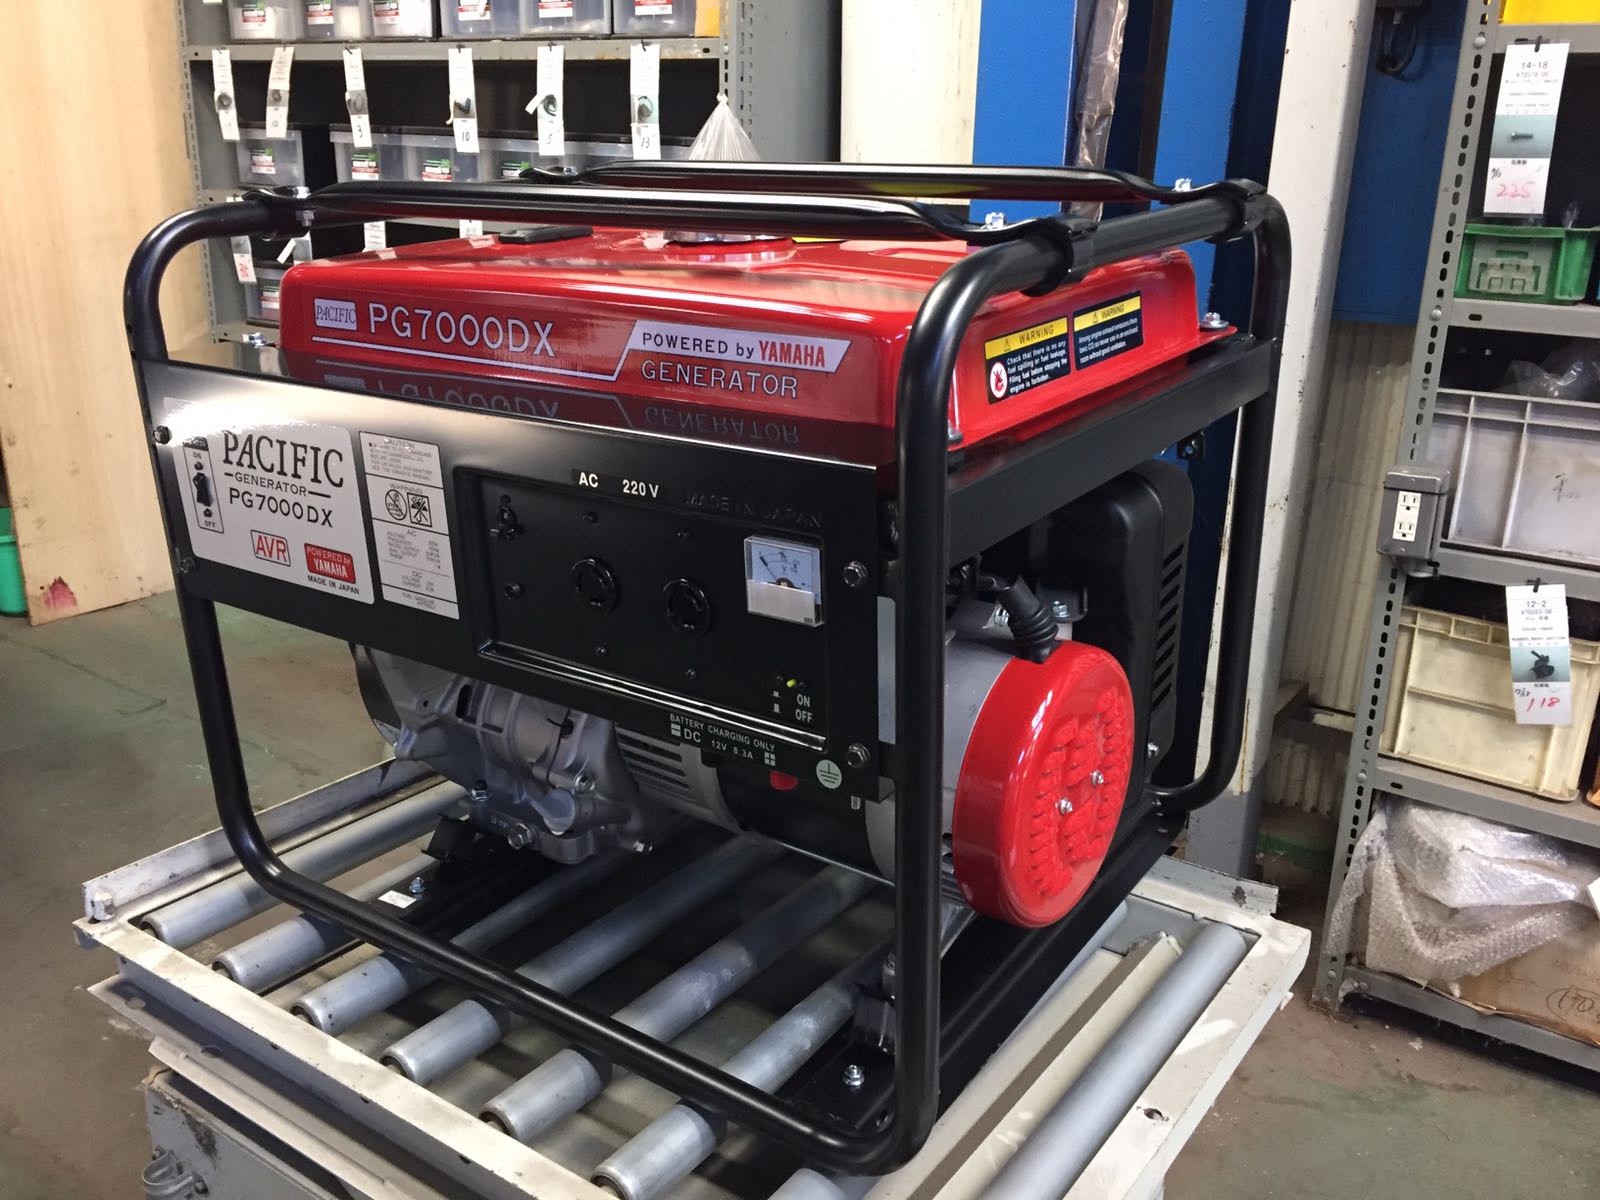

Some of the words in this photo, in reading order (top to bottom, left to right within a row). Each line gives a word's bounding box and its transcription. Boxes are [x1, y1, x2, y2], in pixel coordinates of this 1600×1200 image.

[316, 305, 356, 324] PACIFIC
[368, 302, 556, 357] PG7000DX
[1019, 325, 1054, 344] WARNING
[642, 333, 728, 355] POWERED
[736, 342, 755, 359] by
[759, 340, 825, 368] YAMAHA
[640, 360, 798, 399] GENERATOR
[221, 430, 344, 488] PACIFIC
[235, 472, 307, 496] GENERATOR
[579, 472, 599, 488] AC
[622, 479, 646, 496] 220
[649, 484, 659, 498] V
[229, 487, 334, 527] PG7000DX
[256, 535, 287, 562] AVR
[306, 546, 341, 563] POWERED
[313, 558, 348, 578] YAMAHA
[307, 574, 326, 586] MADE
[338, 584, 360, 595] JAPAN
[1527, 600, 1547, 608] 12-2
[796, 693, 811, 708] ON
[1527, 697, 1560, 712] 118
[795, 709, 813, 723] OFF
[669, 713, 705, 731] BATTERY
[707, 725, 750, 745] CHARGING
[753, 739, 775, 752] ONLY
[684, 728, 701, 743] DC
[711, 740, 727, 751] 12V
